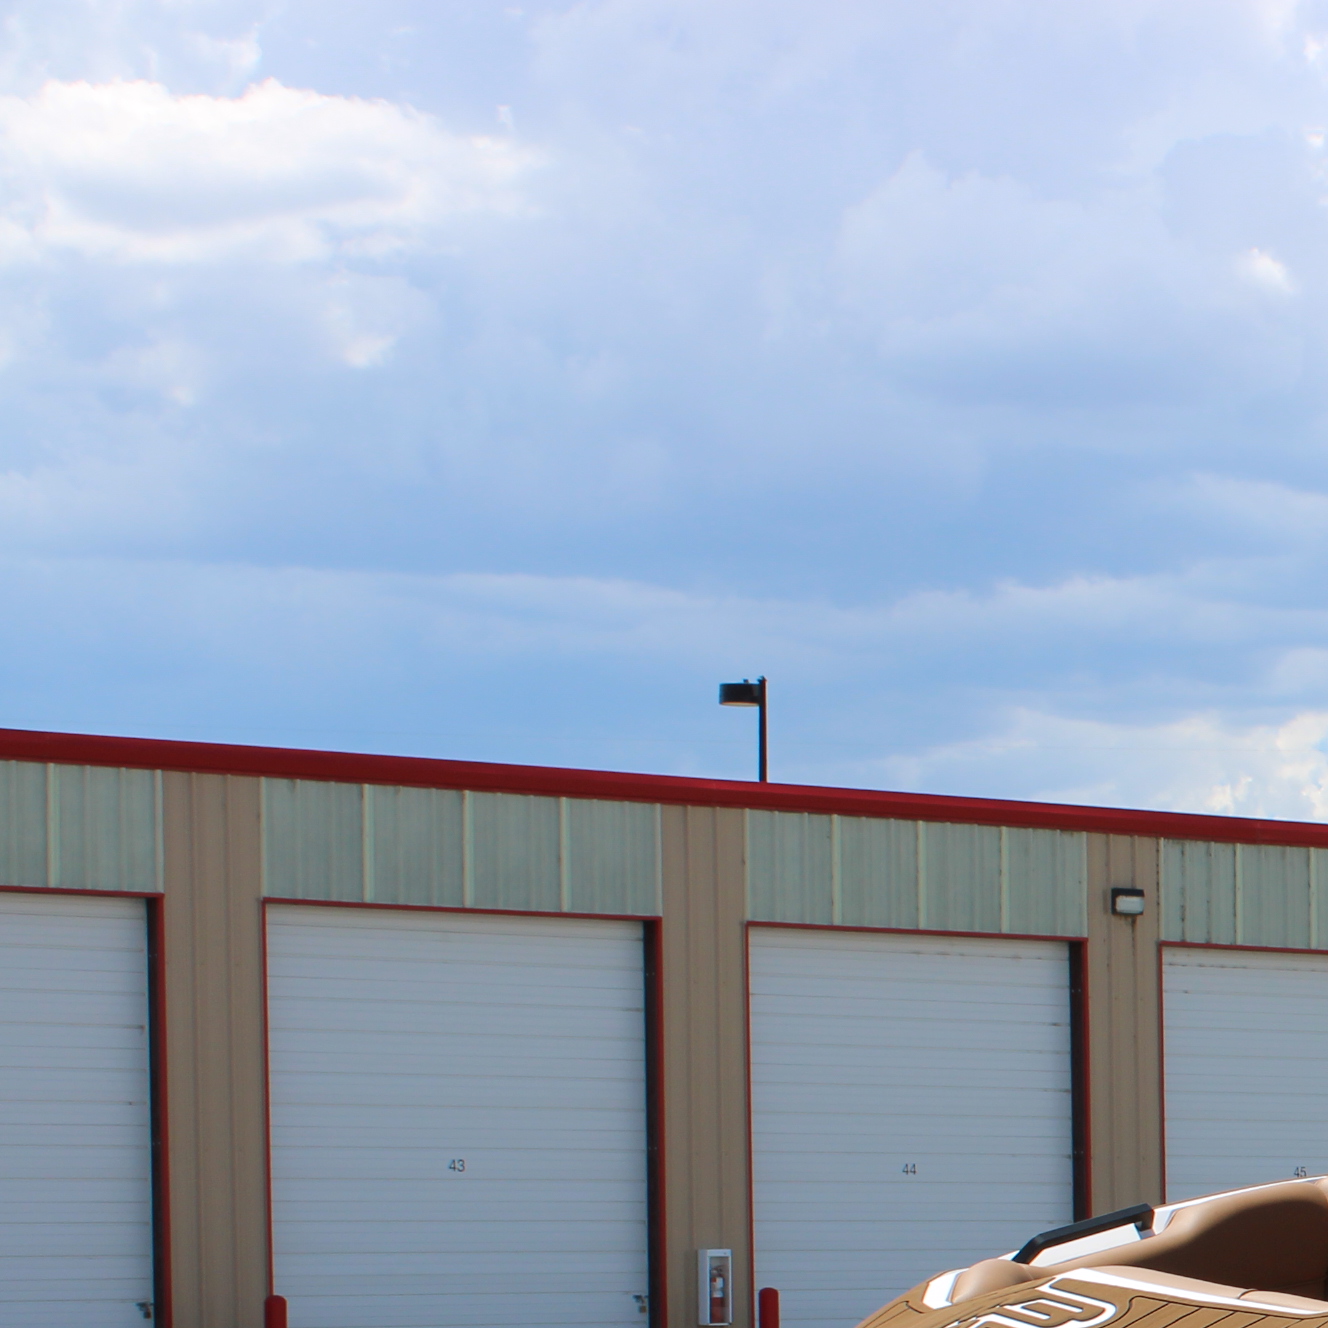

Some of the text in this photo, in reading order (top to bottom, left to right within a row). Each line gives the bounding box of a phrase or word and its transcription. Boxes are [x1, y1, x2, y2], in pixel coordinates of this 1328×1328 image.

[448, 1159, 466, 1172] 43
[902, 1163, 917, 1175] 44
[1293, 1166, 1307, 1178] 45
